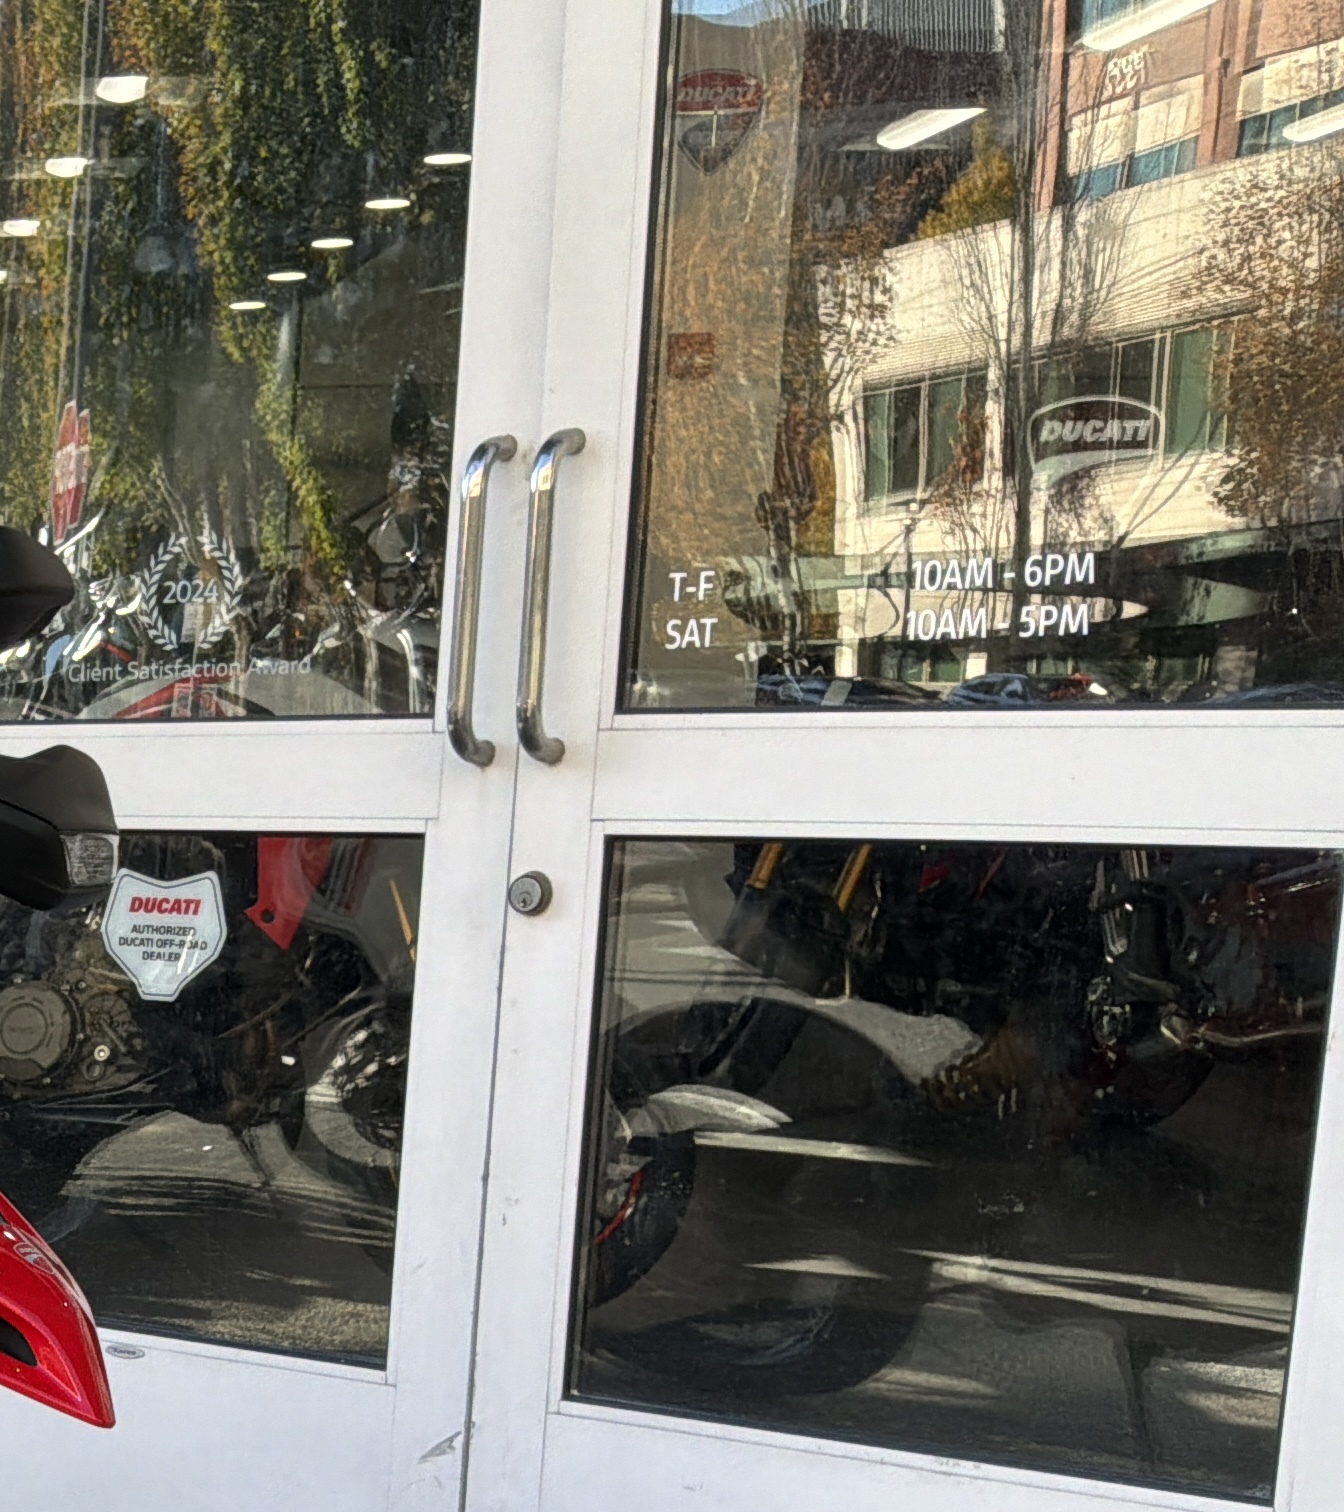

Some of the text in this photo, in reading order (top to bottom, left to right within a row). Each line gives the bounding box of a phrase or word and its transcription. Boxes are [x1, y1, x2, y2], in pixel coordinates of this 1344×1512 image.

[1040, 418, 1151, 443] DUCATI
[669, 571, 715, 601] T-F
[912, 557, 993, 591] 10AM
[1024, 552, 1095, 587] 6PM
[162, 579, 219, 604] 2024
[665, 618, 718, 649] SAT
[906, 607, 987, 641] 10AM
[1019, 603, 1089, 638] 5PM
[68, 656, 312, 684] Client Satisfaction Award
[129, 896, 202, 916] DUCATI
[131, 924, 197, 937] AUTHORIZED
[118, 936, 208, 951] DUCATI OFF-ROAD
[141, 950, 182, 962] DEALER
